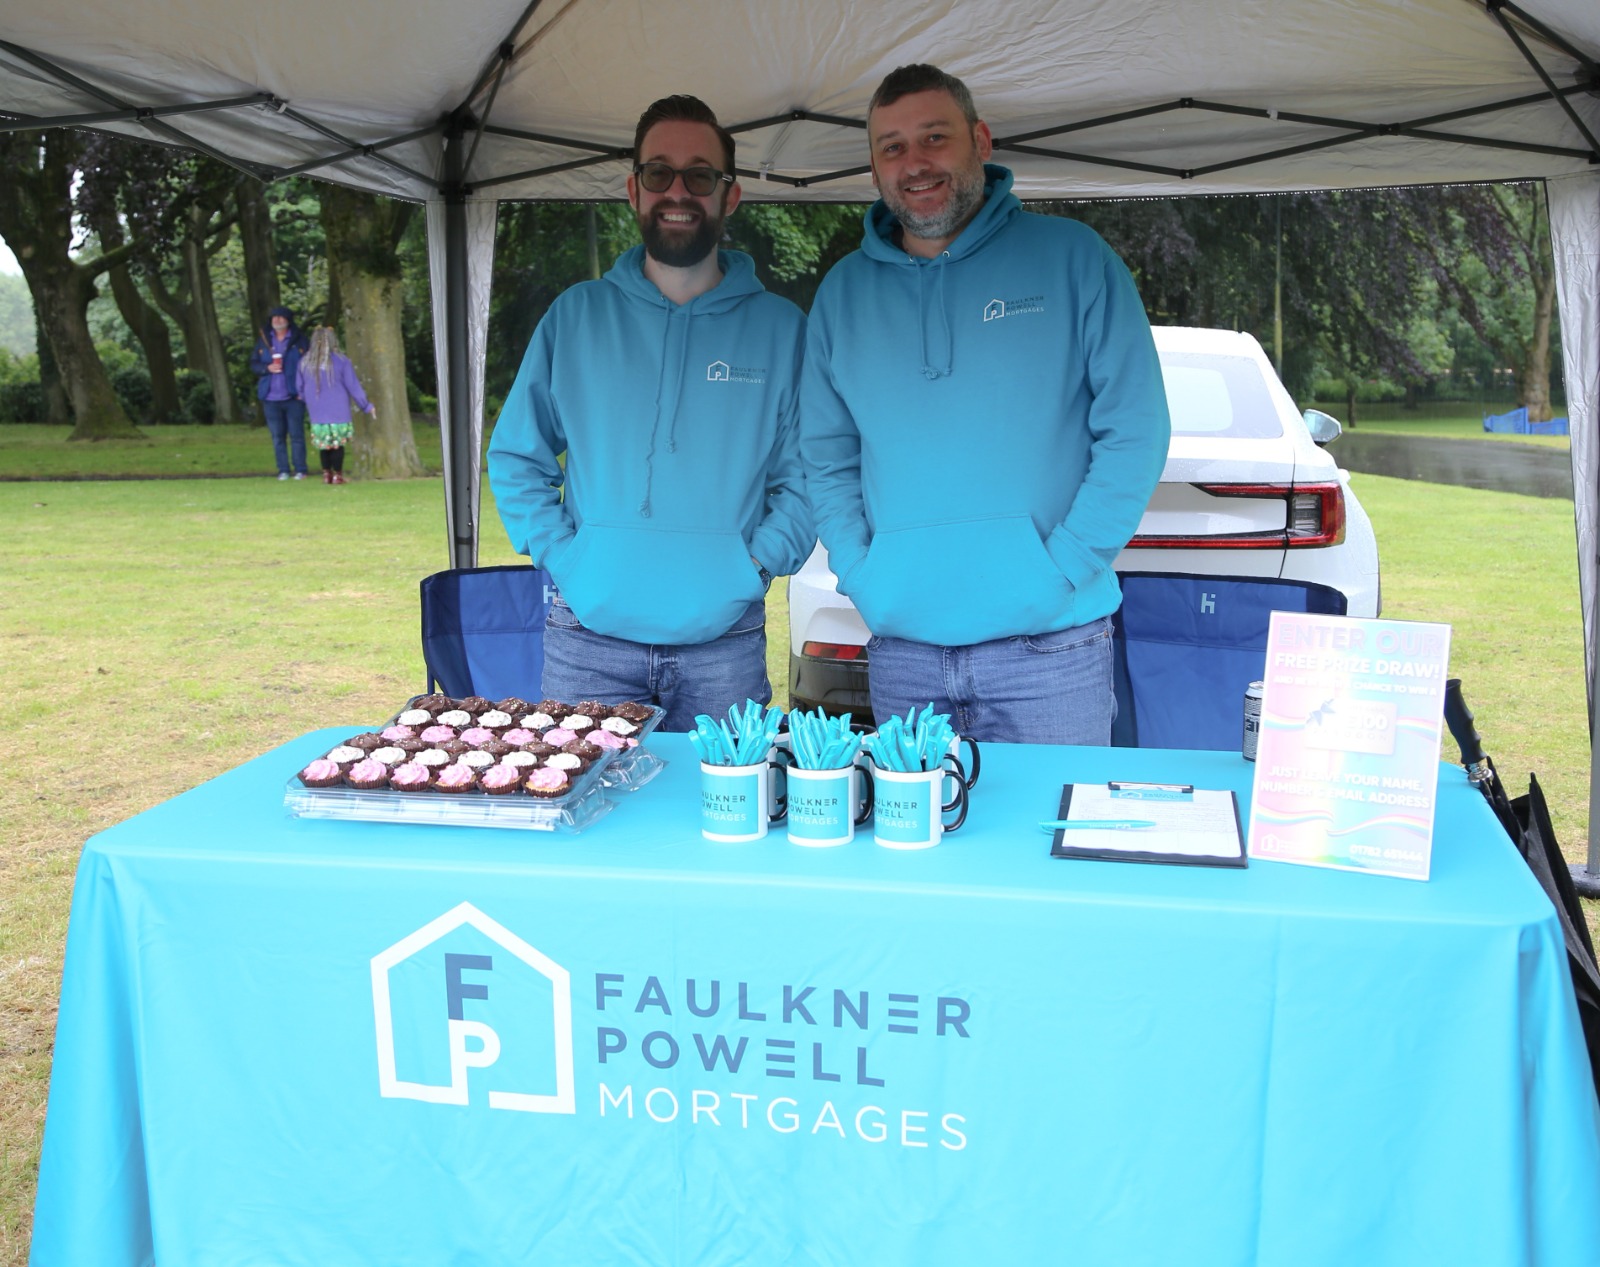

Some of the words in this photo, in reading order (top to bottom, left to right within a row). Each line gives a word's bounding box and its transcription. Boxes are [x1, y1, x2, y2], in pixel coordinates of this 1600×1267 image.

[1278, 622, 1367, 651] ENTER
[1376, 630, 1442, 657] OUR
[1275, 653, 1318, 669] FREE
[1322, 656, 1371, 674] PRIZE
[1376, 660, 1440, 678] DRAW!
[1260, 780, 1313, 796] NUMBER
[1329, 788, 1368, 802] EMAIL
[1368, 793, 1430, 809] ADDRESS
[1268, 765, 1300, 778] JUST
[1301, 768, 1341, 784] LEAVE
[1344, 772, 1380, 787] YOUR
[1382, 776, 1424, 792] NAME,
[595, 972, 972, 1039] FAULKNER
[597, 1026, 885, 1088] POWELL
[599, 1083, 968, 1151] MORTGAGES
